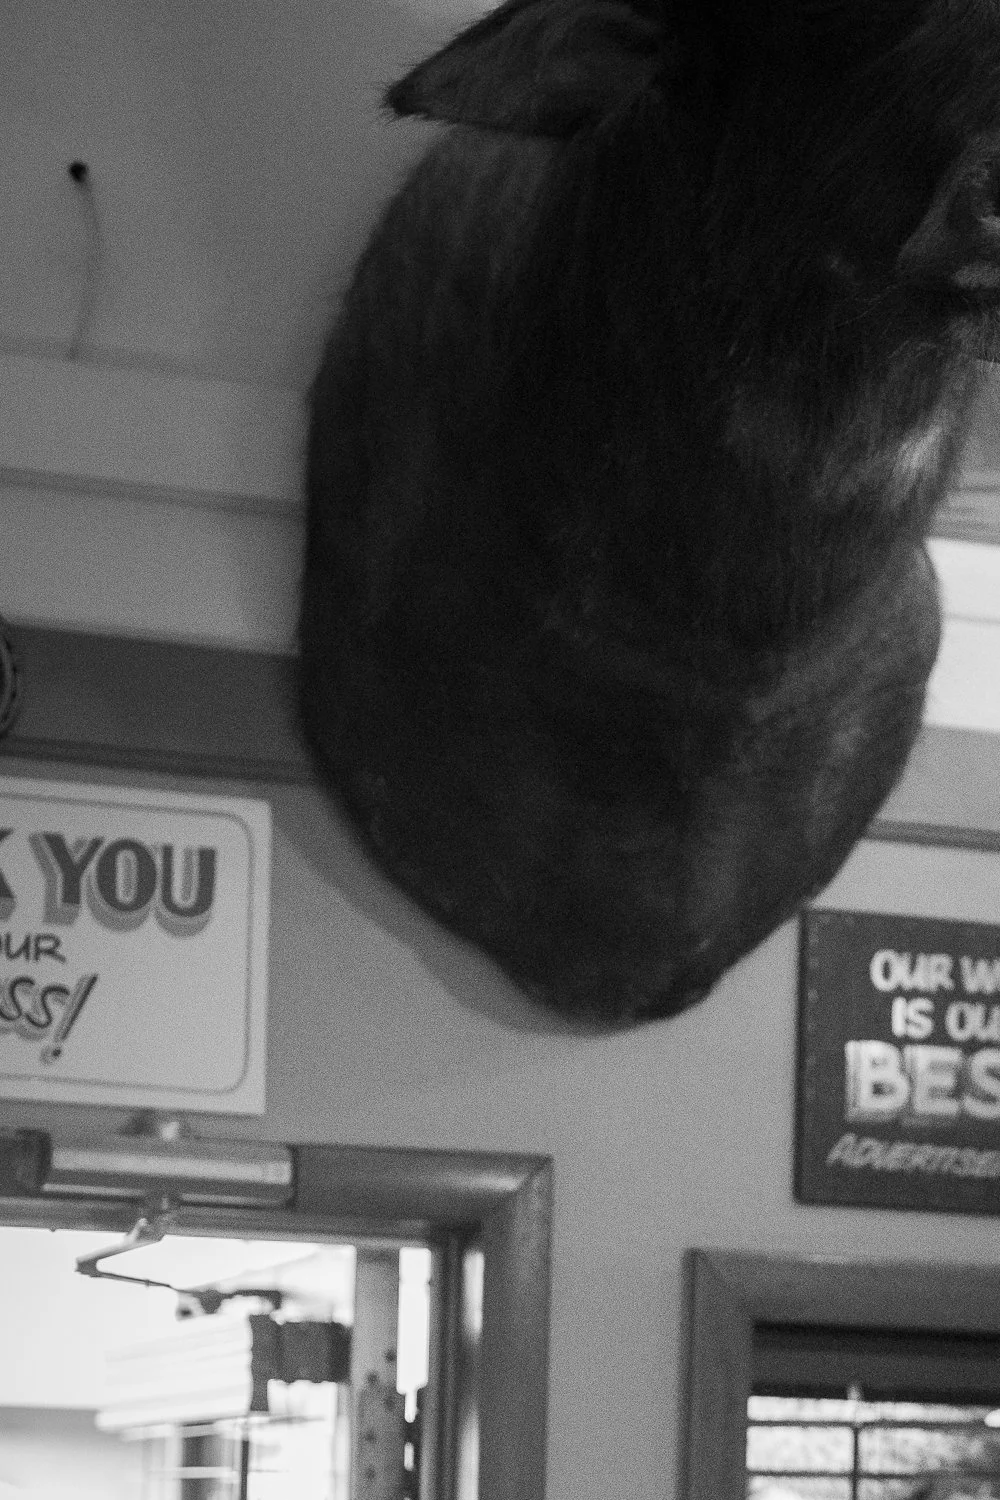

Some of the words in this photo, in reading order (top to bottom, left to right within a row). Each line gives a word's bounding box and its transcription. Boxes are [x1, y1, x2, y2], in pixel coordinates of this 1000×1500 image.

[36, 831, 217, 930] YOU
[0, 931, 67, 963] UR
[869, 949, 955, 993] OUR
[891, 996, 934, 1040] IS
